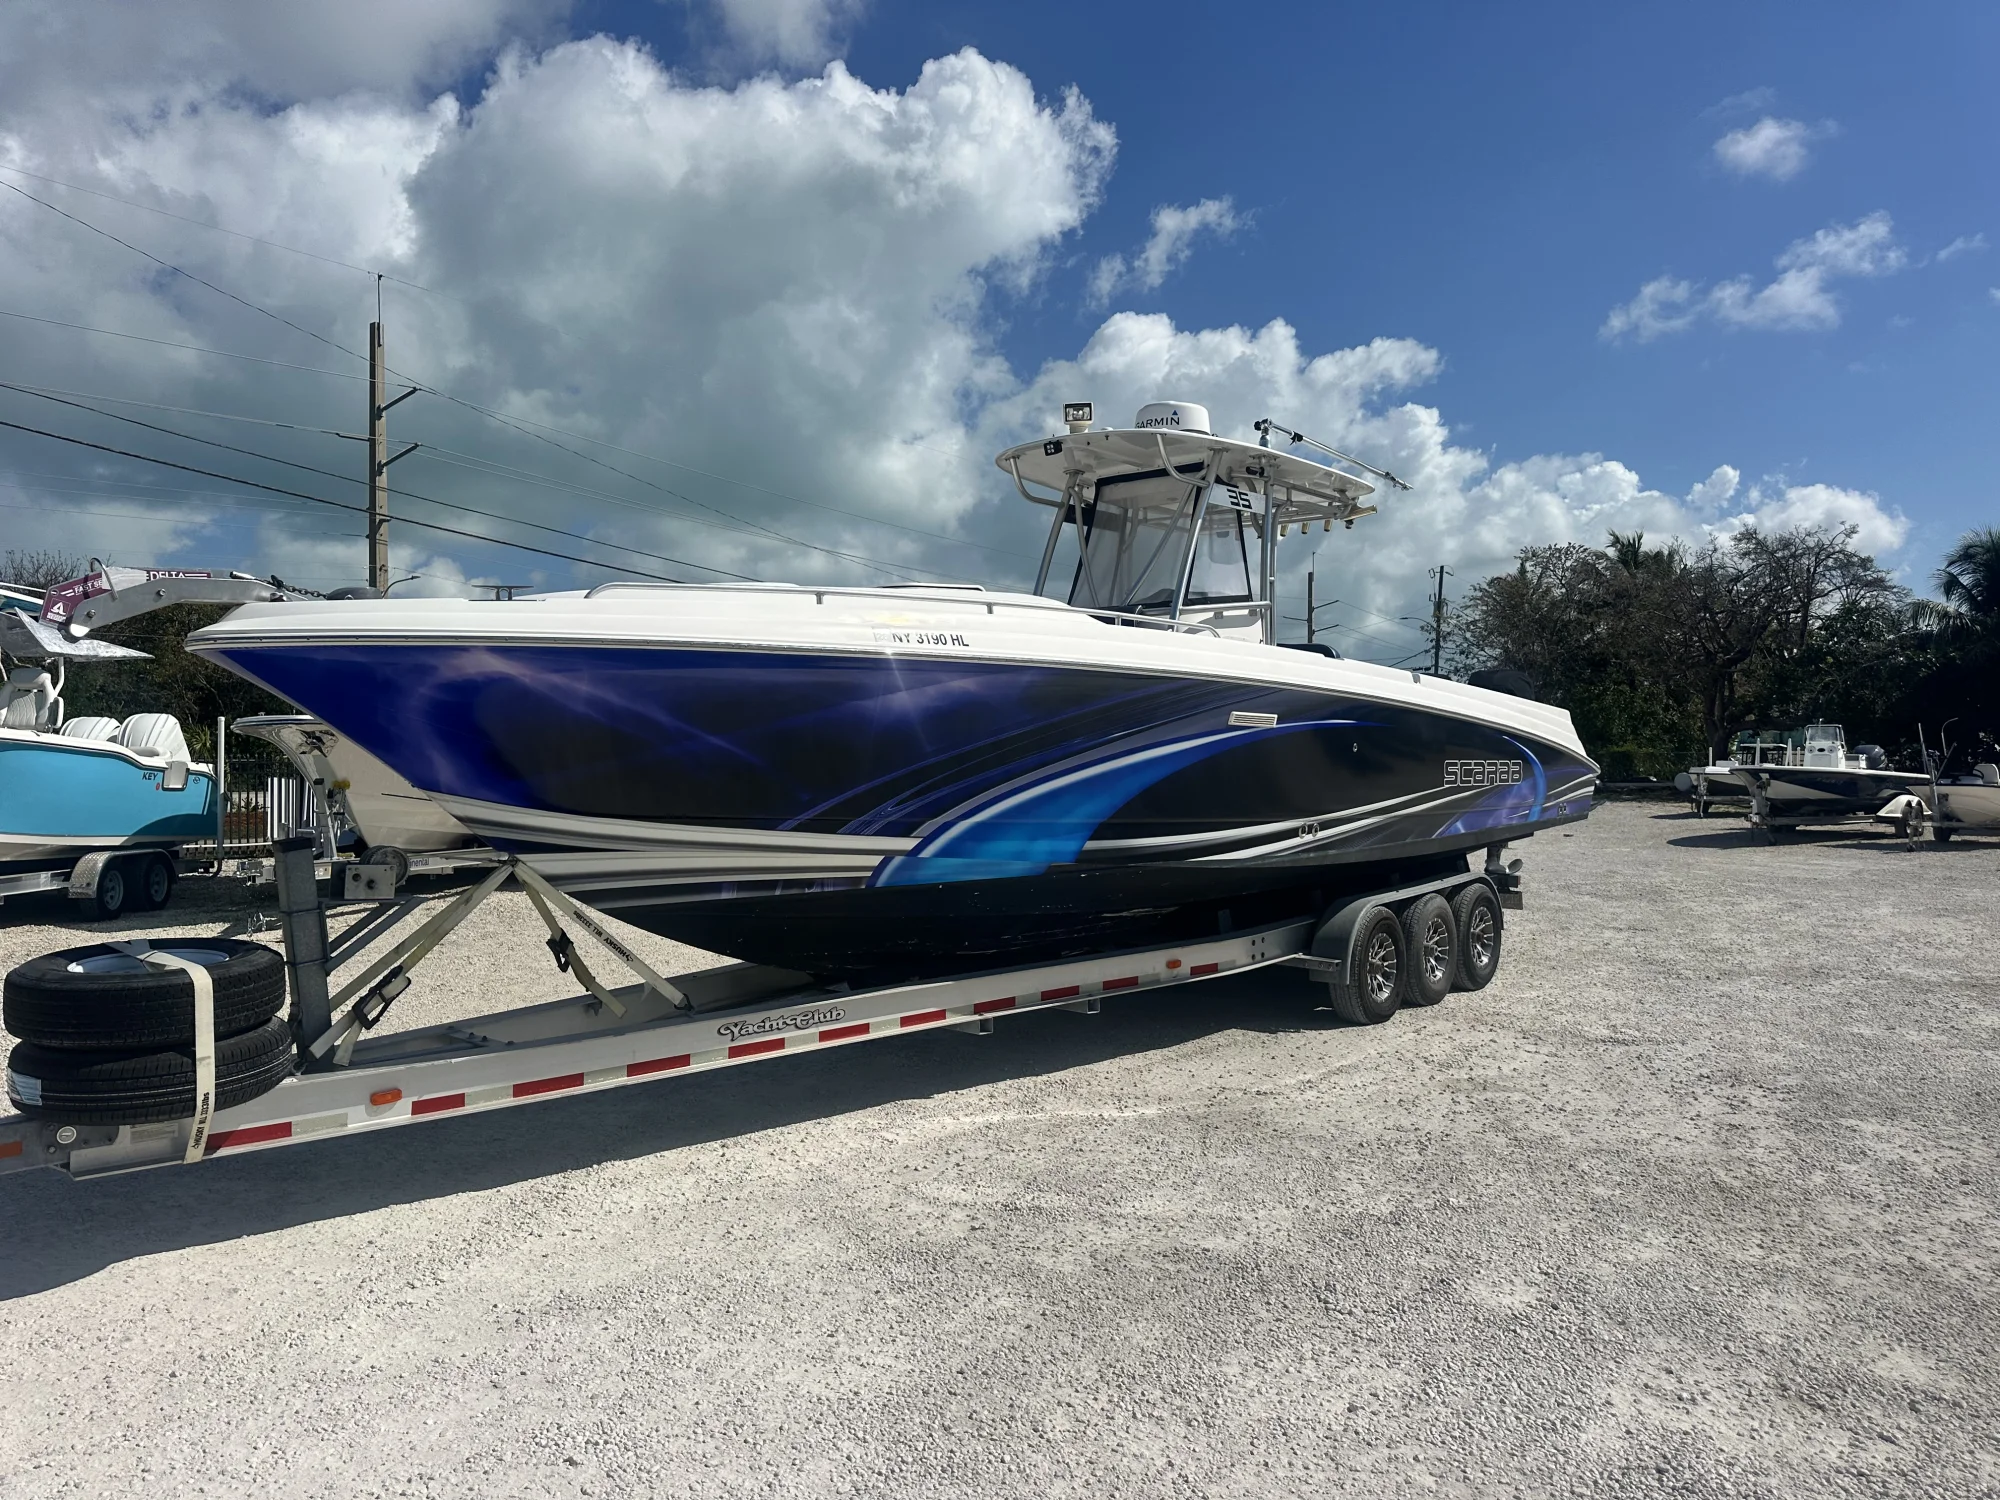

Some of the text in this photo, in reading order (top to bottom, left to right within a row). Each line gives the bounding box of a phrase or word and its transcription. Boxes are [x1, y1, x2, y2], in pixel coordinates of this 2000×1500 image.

[1135, 416, 1180, 429] GARMIN
[1226, 488, 1253, 510] 35
[892, 632, 911, 644] NY
[916, 632, 948, 646] 3190
[950, 633, 970, 647] HL
[142, 771, 159, 781] KEY
[603, 937, 627, 957] HUSKY
